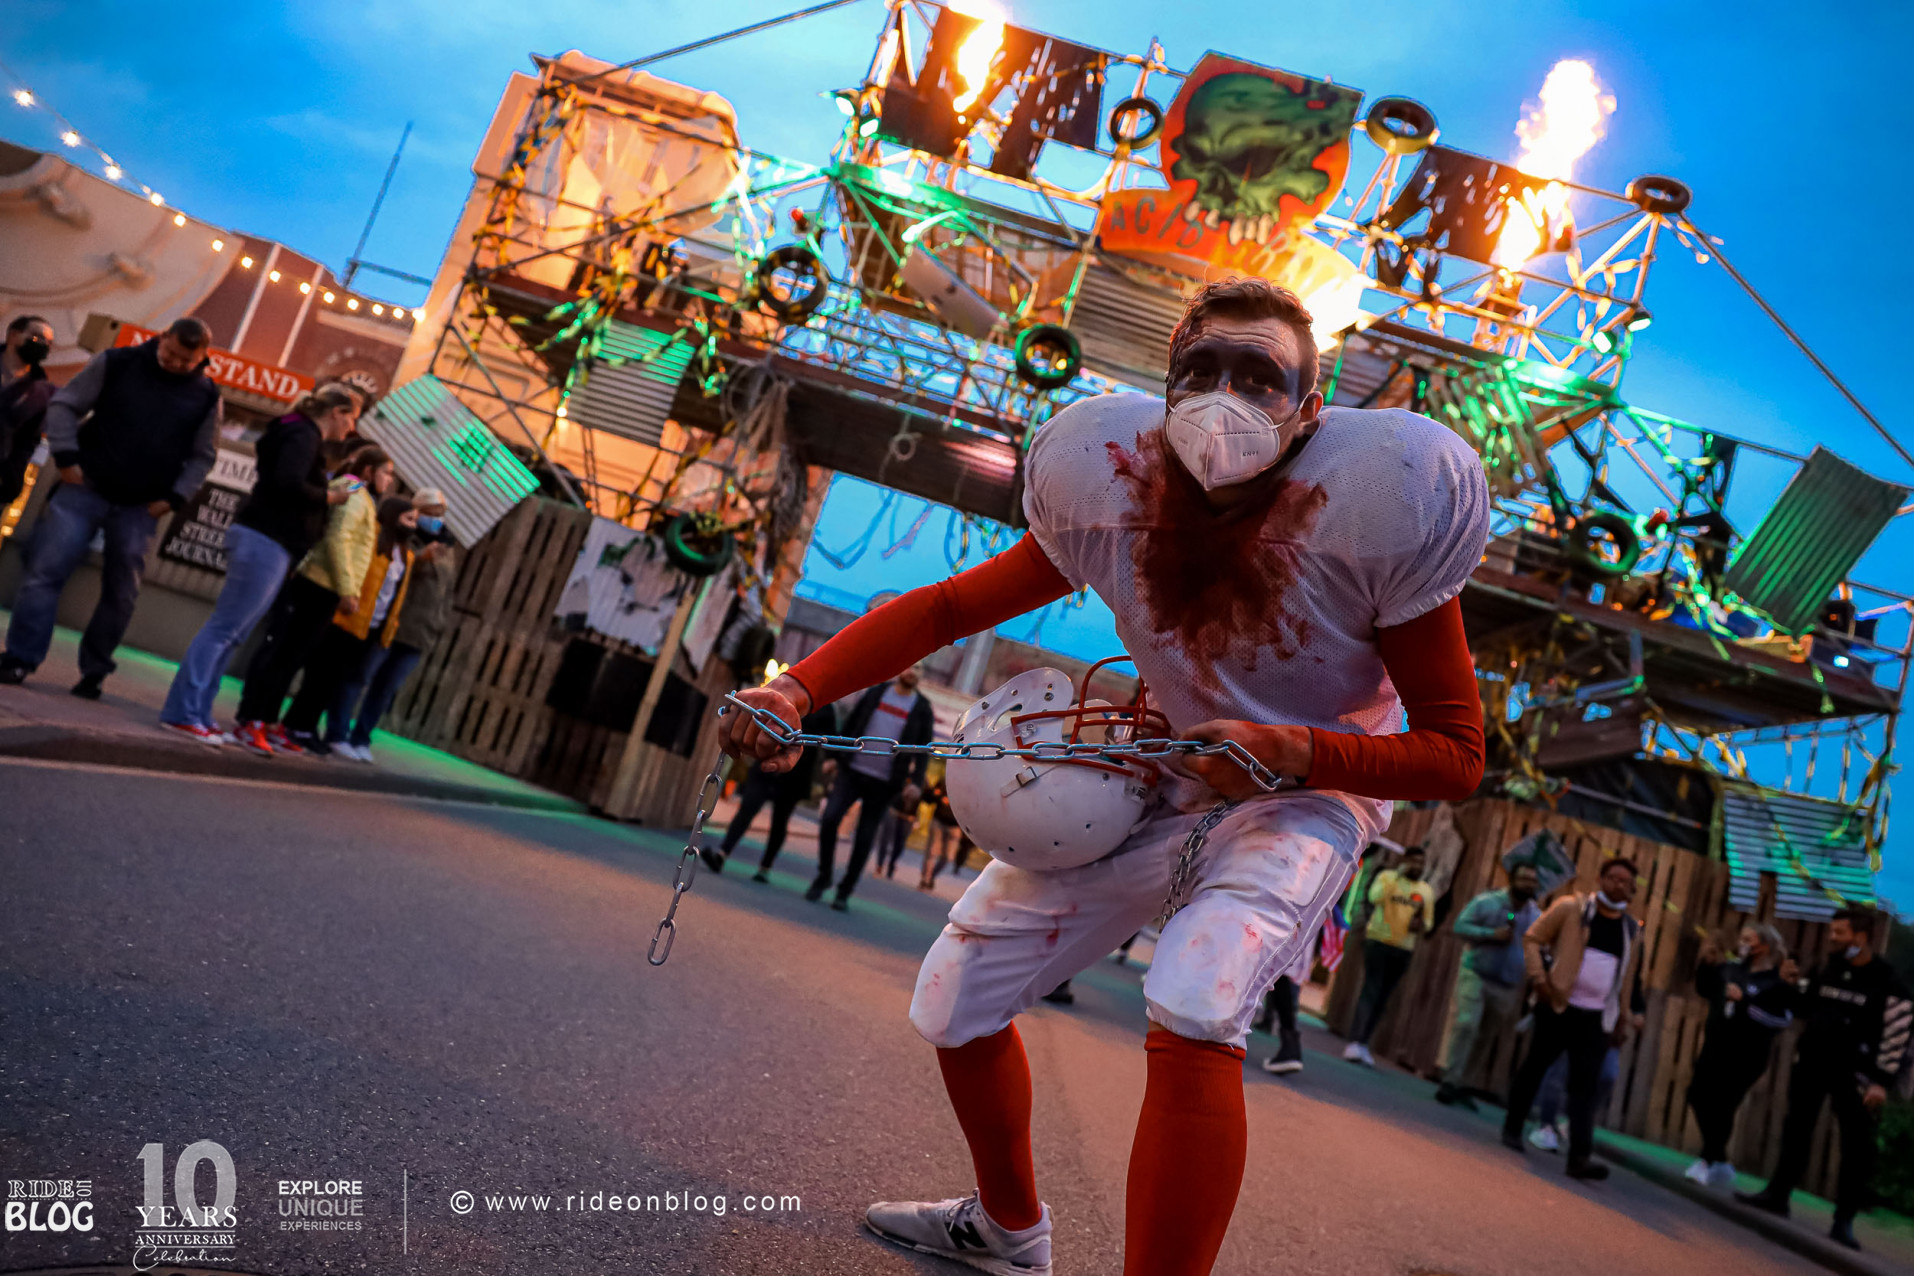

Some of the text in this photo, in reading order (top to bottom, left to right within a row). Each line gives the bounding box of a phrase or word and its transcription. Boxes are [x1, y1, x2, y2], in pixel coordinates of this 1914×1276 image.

[208, 488, 240, 513] THE
[180, 520, 226, 549] STREE
[164, 536, 228, 570] JOURNA
